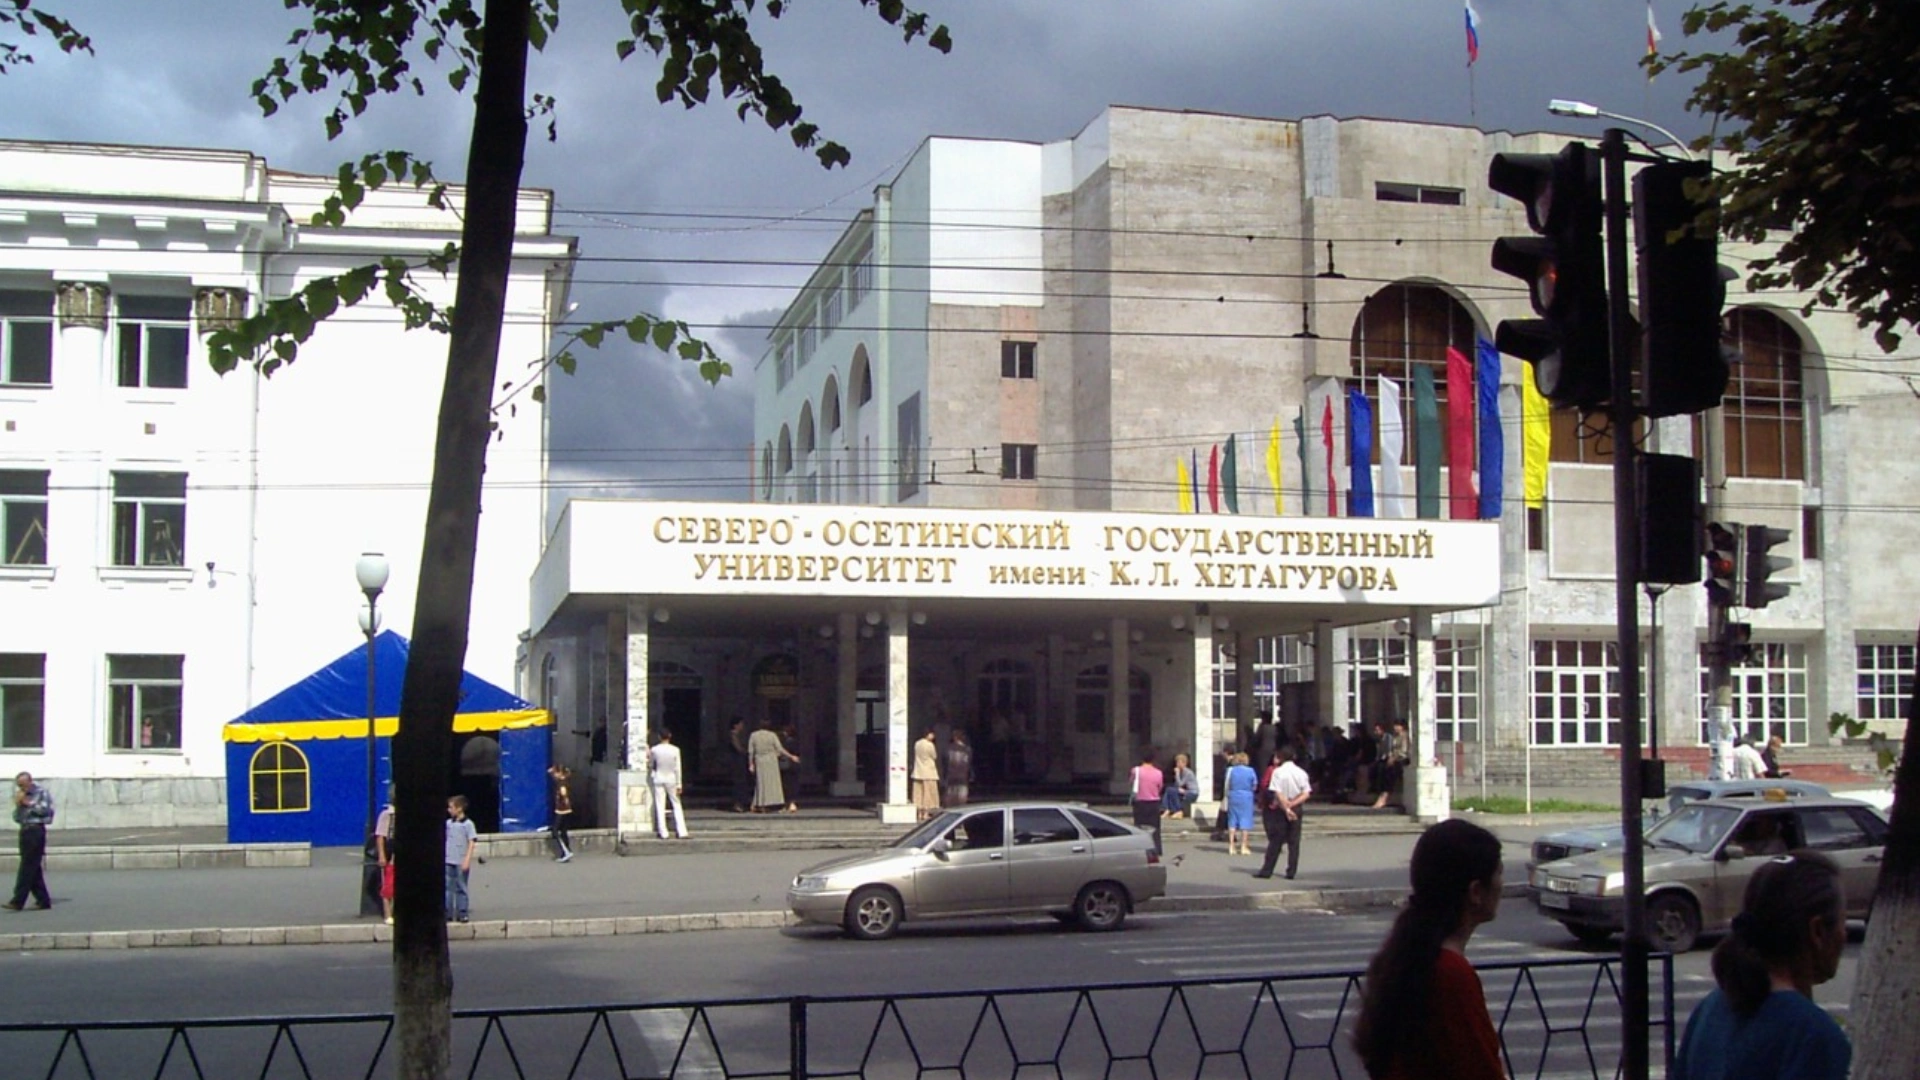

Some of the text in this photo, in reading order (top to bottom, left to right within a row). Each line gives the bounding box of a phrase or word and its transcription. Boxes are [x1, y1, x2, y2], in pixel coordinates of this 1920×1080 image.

[653, 516, 795, 547] СЕВЕРО
[822, 518, 1070, 550] ОСЕТИНСКИЙ
[1103, 525, 1435, 559] ГОСУДАРСТВЕННЫЙ
[693, 553, 957, 583] УНИВЕРСИТЕТ
[989, 566, 1086, 585] имени
[1194, 562, 1399, 593] ХЕТАГУРОВА
